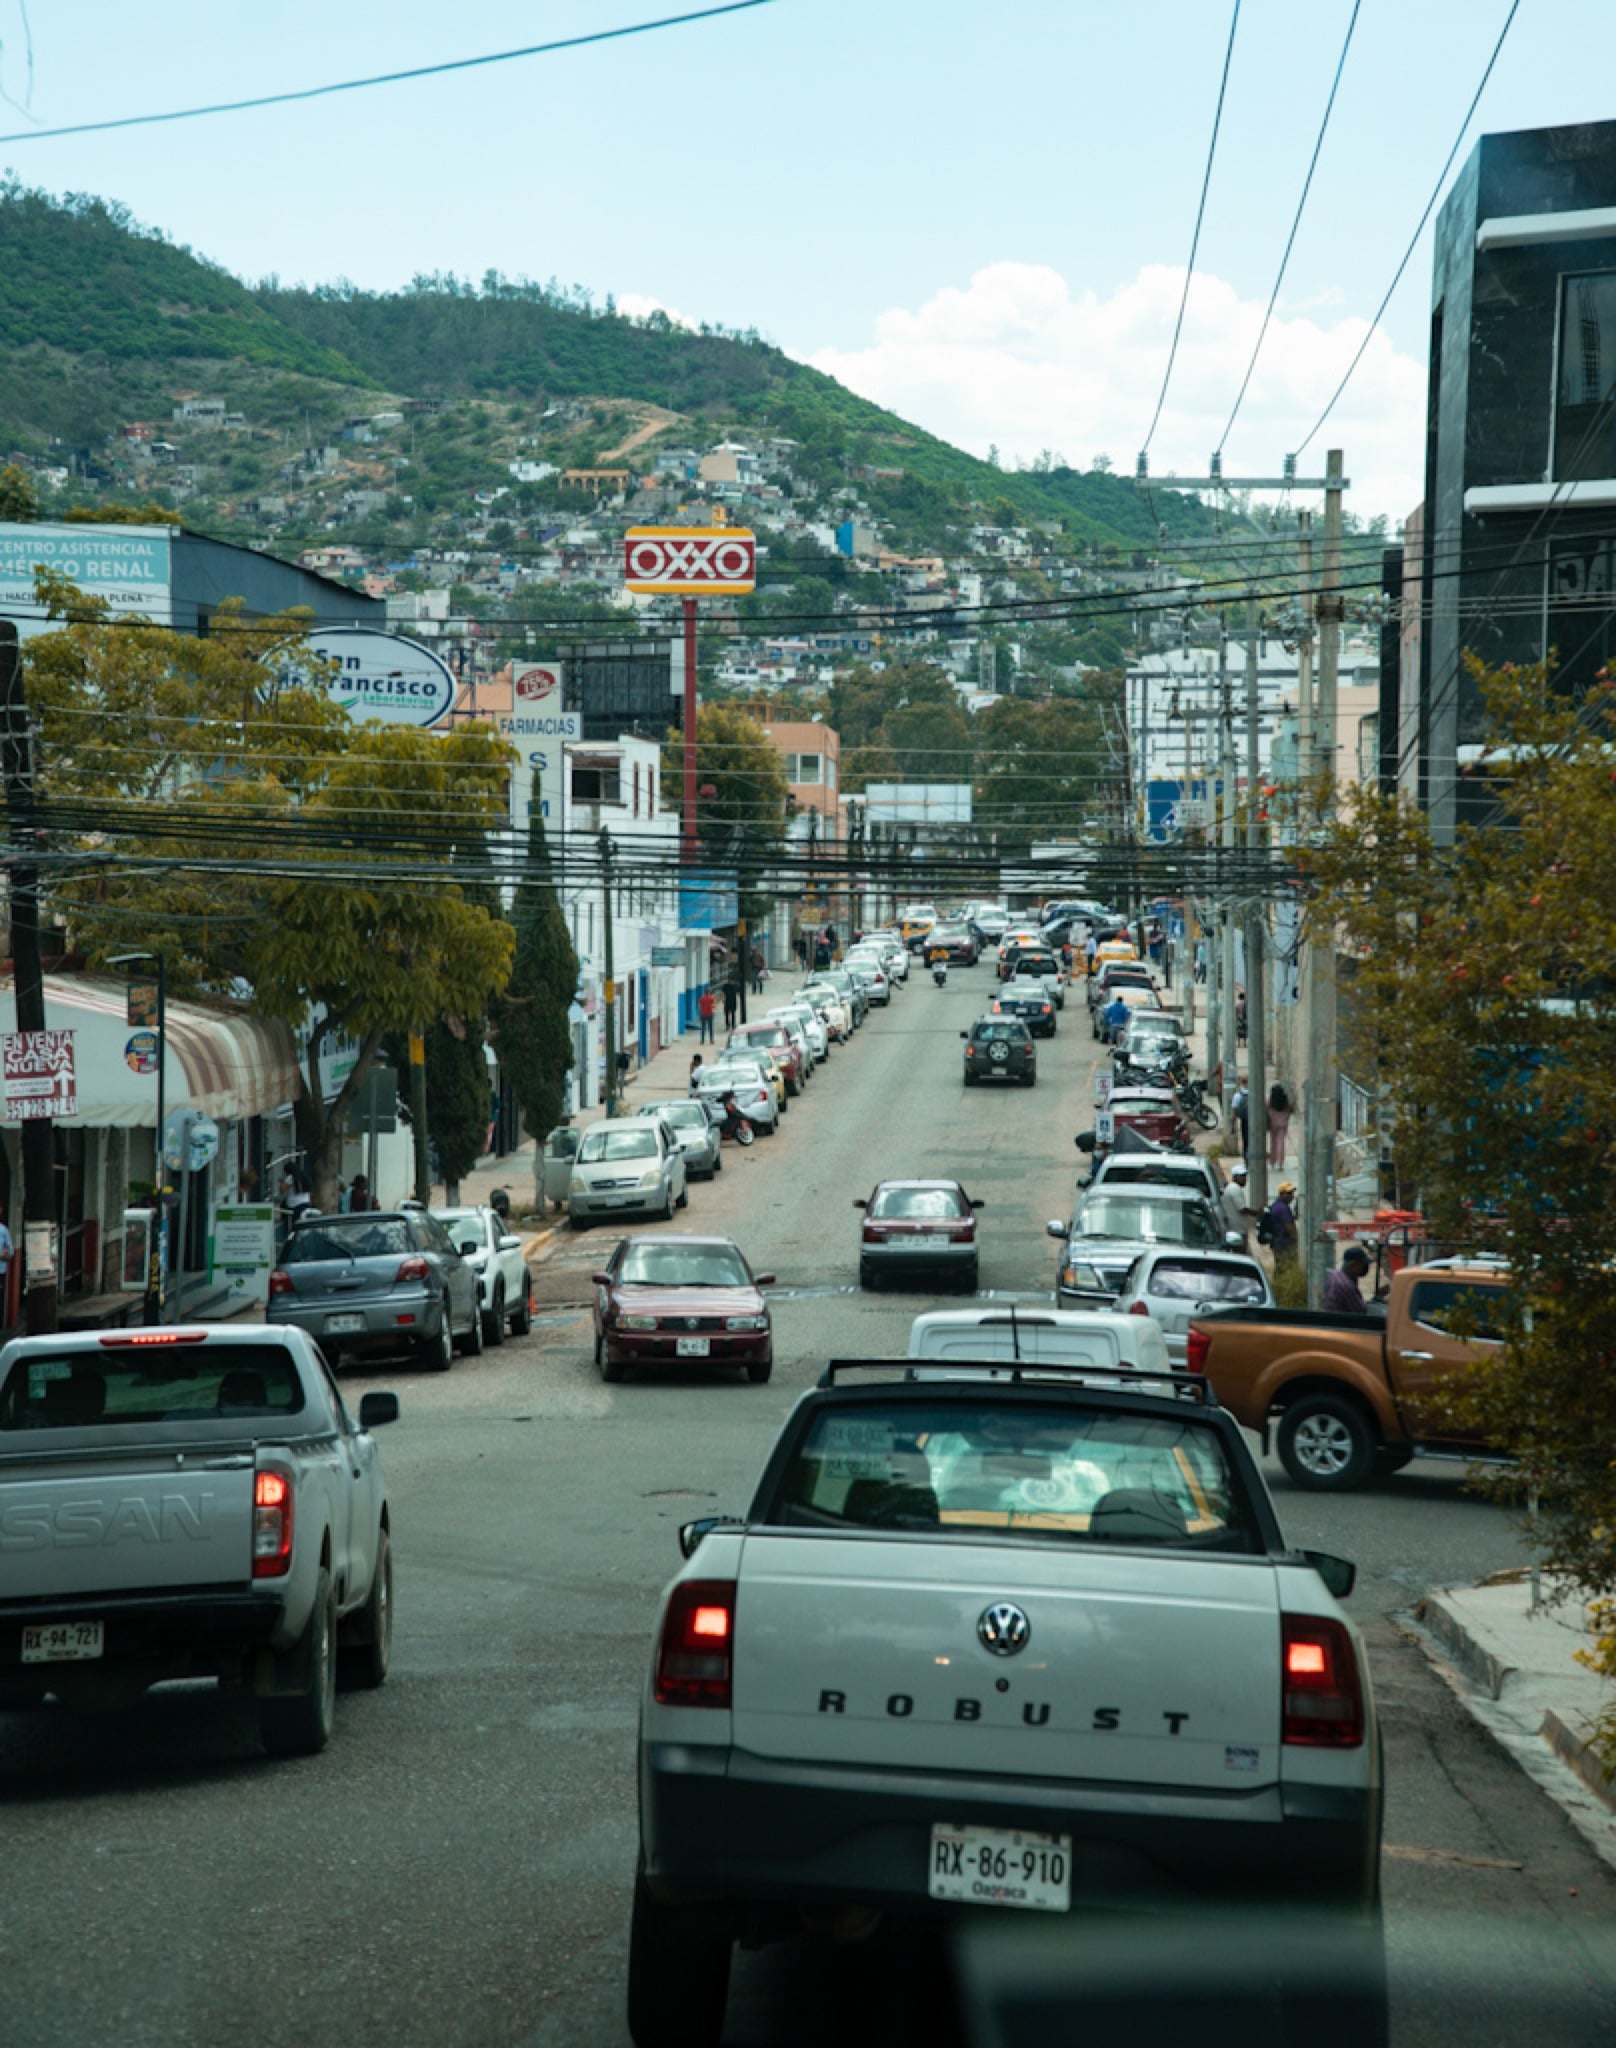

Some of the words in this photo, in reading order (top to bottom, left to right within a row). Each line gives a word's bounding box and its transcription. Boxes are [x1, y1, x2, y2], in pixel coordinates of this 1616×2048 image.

[60, 541, 155, 556] ASISTENCIAL
[87, 560, 155, 578] RENAL
[630, 541, 750, 579] OXXO
[501, 717, 575, 735] FARMACIAS
[4, 1033, 22, 1051] EN
[26, 1029, 72, 1049] VENTA
[8, 1048, 69, 1063] CASA
[6, 1060, 72, 1073] NUEVA
[25, 1624, 99, 1649] RX-94-721
[819, 1689, 1189, 1735] ROBUST
[936, 1841, 1065, 1885] RX-86-910
